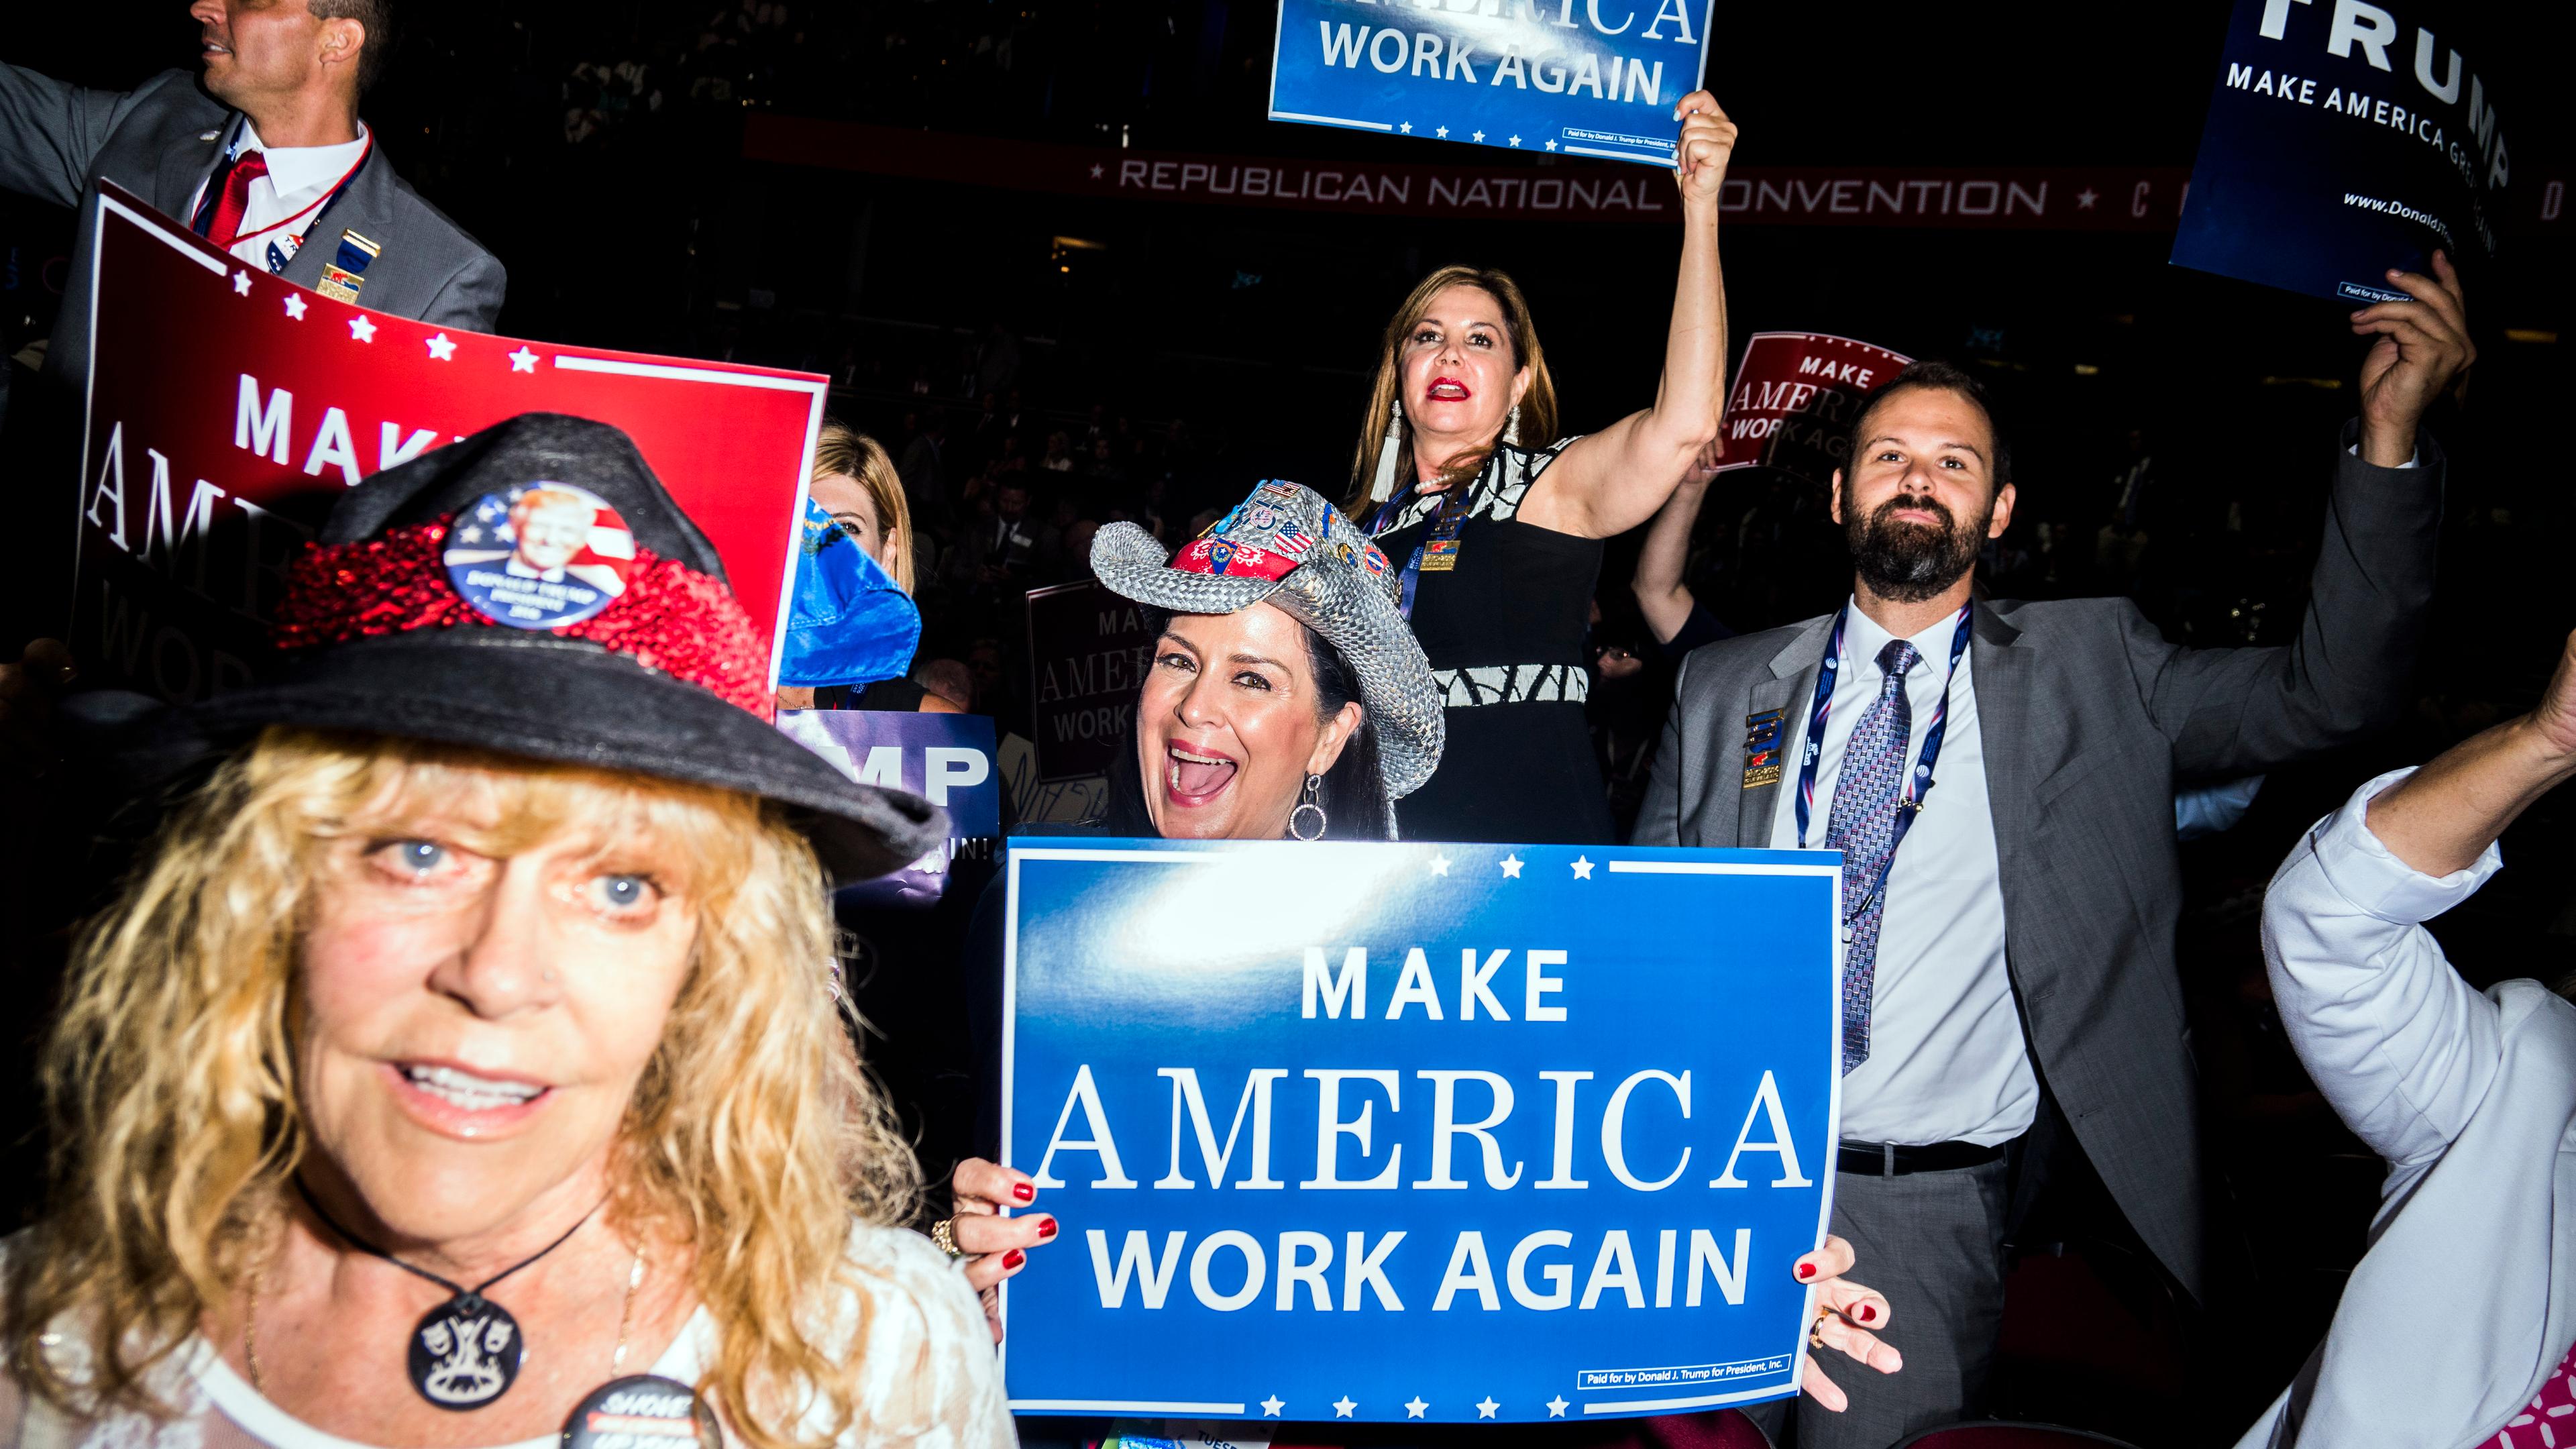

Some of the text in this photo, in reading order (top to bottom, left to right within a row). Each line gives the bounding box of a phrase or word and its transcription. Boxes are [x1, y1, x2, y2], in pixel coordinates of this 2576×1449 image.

[1320, 21, 1477, 84] WORK
[1491, 44, 1664, 105] AGAIN
[2226, 62, 2318, 105] MAKE
[2323, 87, 2445, 152] AMERICA
[1579, 130, 1588, 138] for
[1588, 131, 1595, 140] by
[1595, 133, 1614, 142] Donald
[1619, 136, 1635, 144] Trump
[1644, 138, 1669, 148] President,
[1117, 158, 2049, 217] REPUBLICAN NATIONAL ONVENTION
[2345, 285, 2360, 295] Paid
[2360, 289, 2371, 297] for
[1799, 355, 1874, 390] MAKE
[235, 373, 472, 486] MAK
[1729, 380, 1865, 427] AMERI
[1731, 417, 1802, 442] WORK
[1053, 704, 1131, 744] WORK
[1301, 947, 1569, 1022] MAKE
[1034, 1063, 1813, 1192] AMERICA
[1085, 1228, 1752, 1312] WORK AGAIN
[1587, 1358, 1783, 1385] Paid for by Donald J. Trump for President, Inc.
